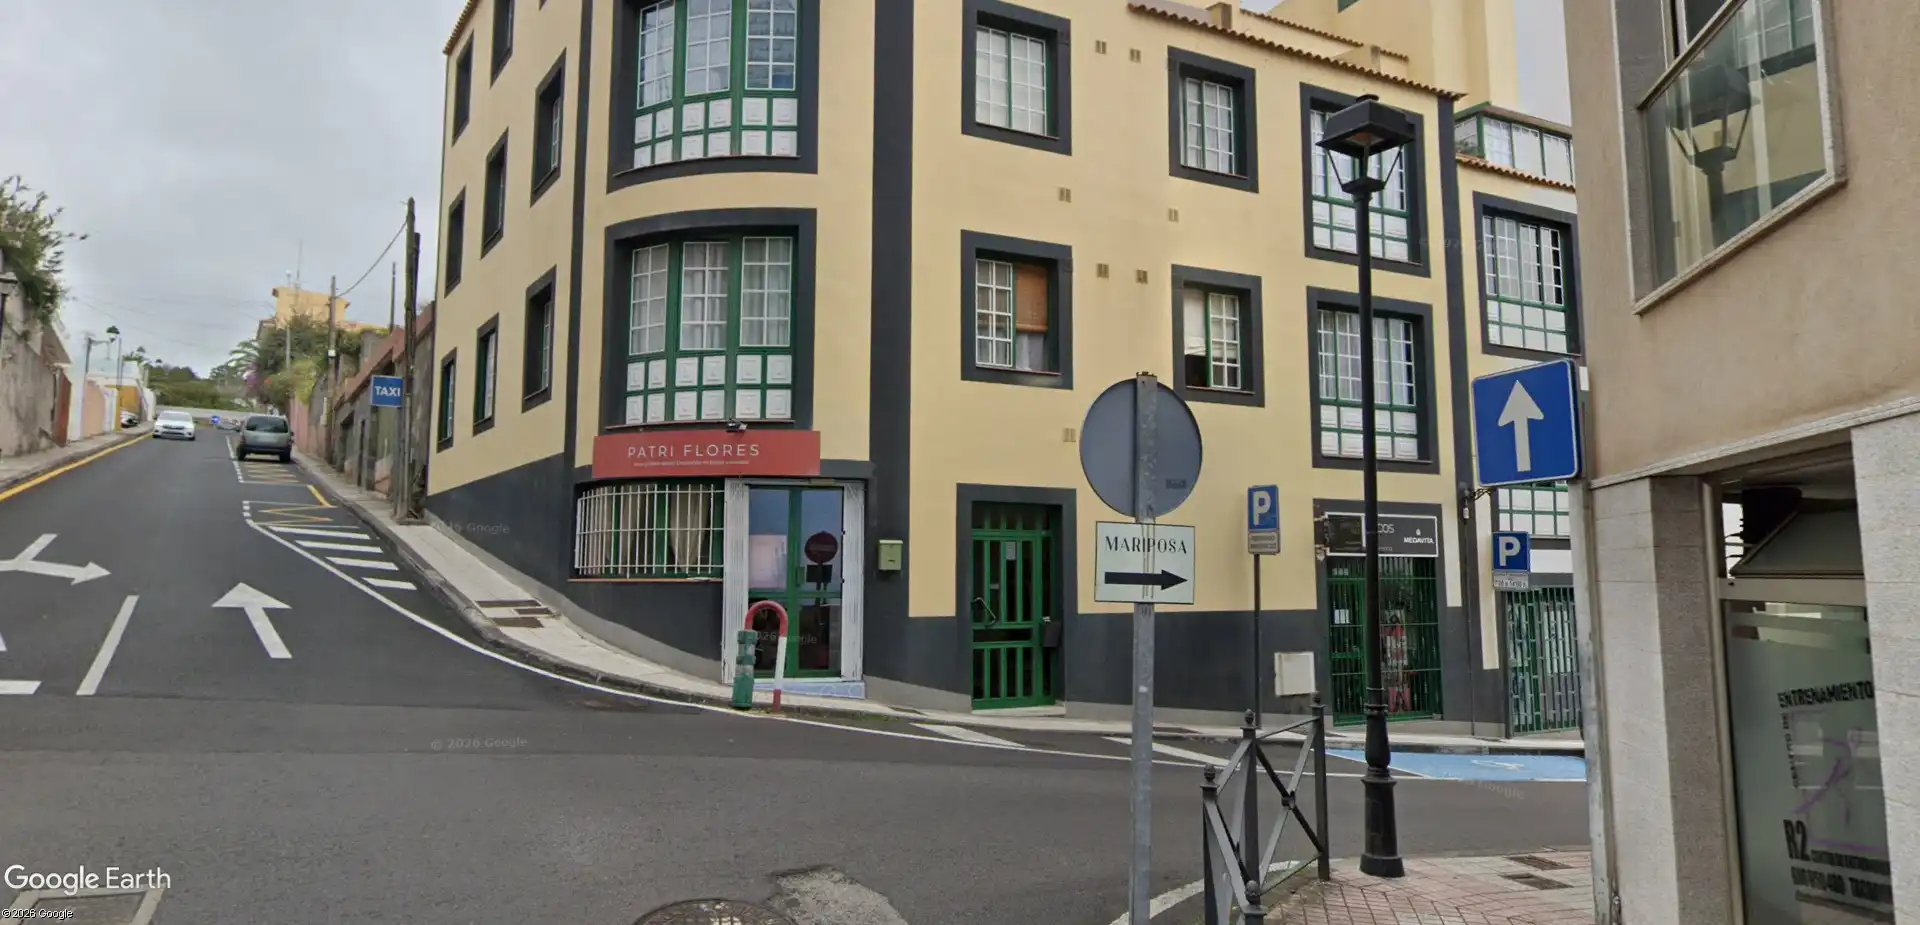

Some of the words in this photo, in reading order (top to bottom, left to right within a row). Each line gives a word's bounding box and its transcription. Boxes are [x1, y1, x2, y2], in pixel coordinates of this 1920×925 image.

[374, 385, 401, 396] TAXI
[628, 445, 674, 458] PATRI
[683, 444, 760, 457] FLORES
[1253, 490, 1271, 526] P
[1105, 535, 1187, 554] MARIPOSA
[1499, 536, 1520, 566] P
[1777, 681, 1874, 708] ENTRENAMIENTO
[1783, 819, 1810, 861] R2
